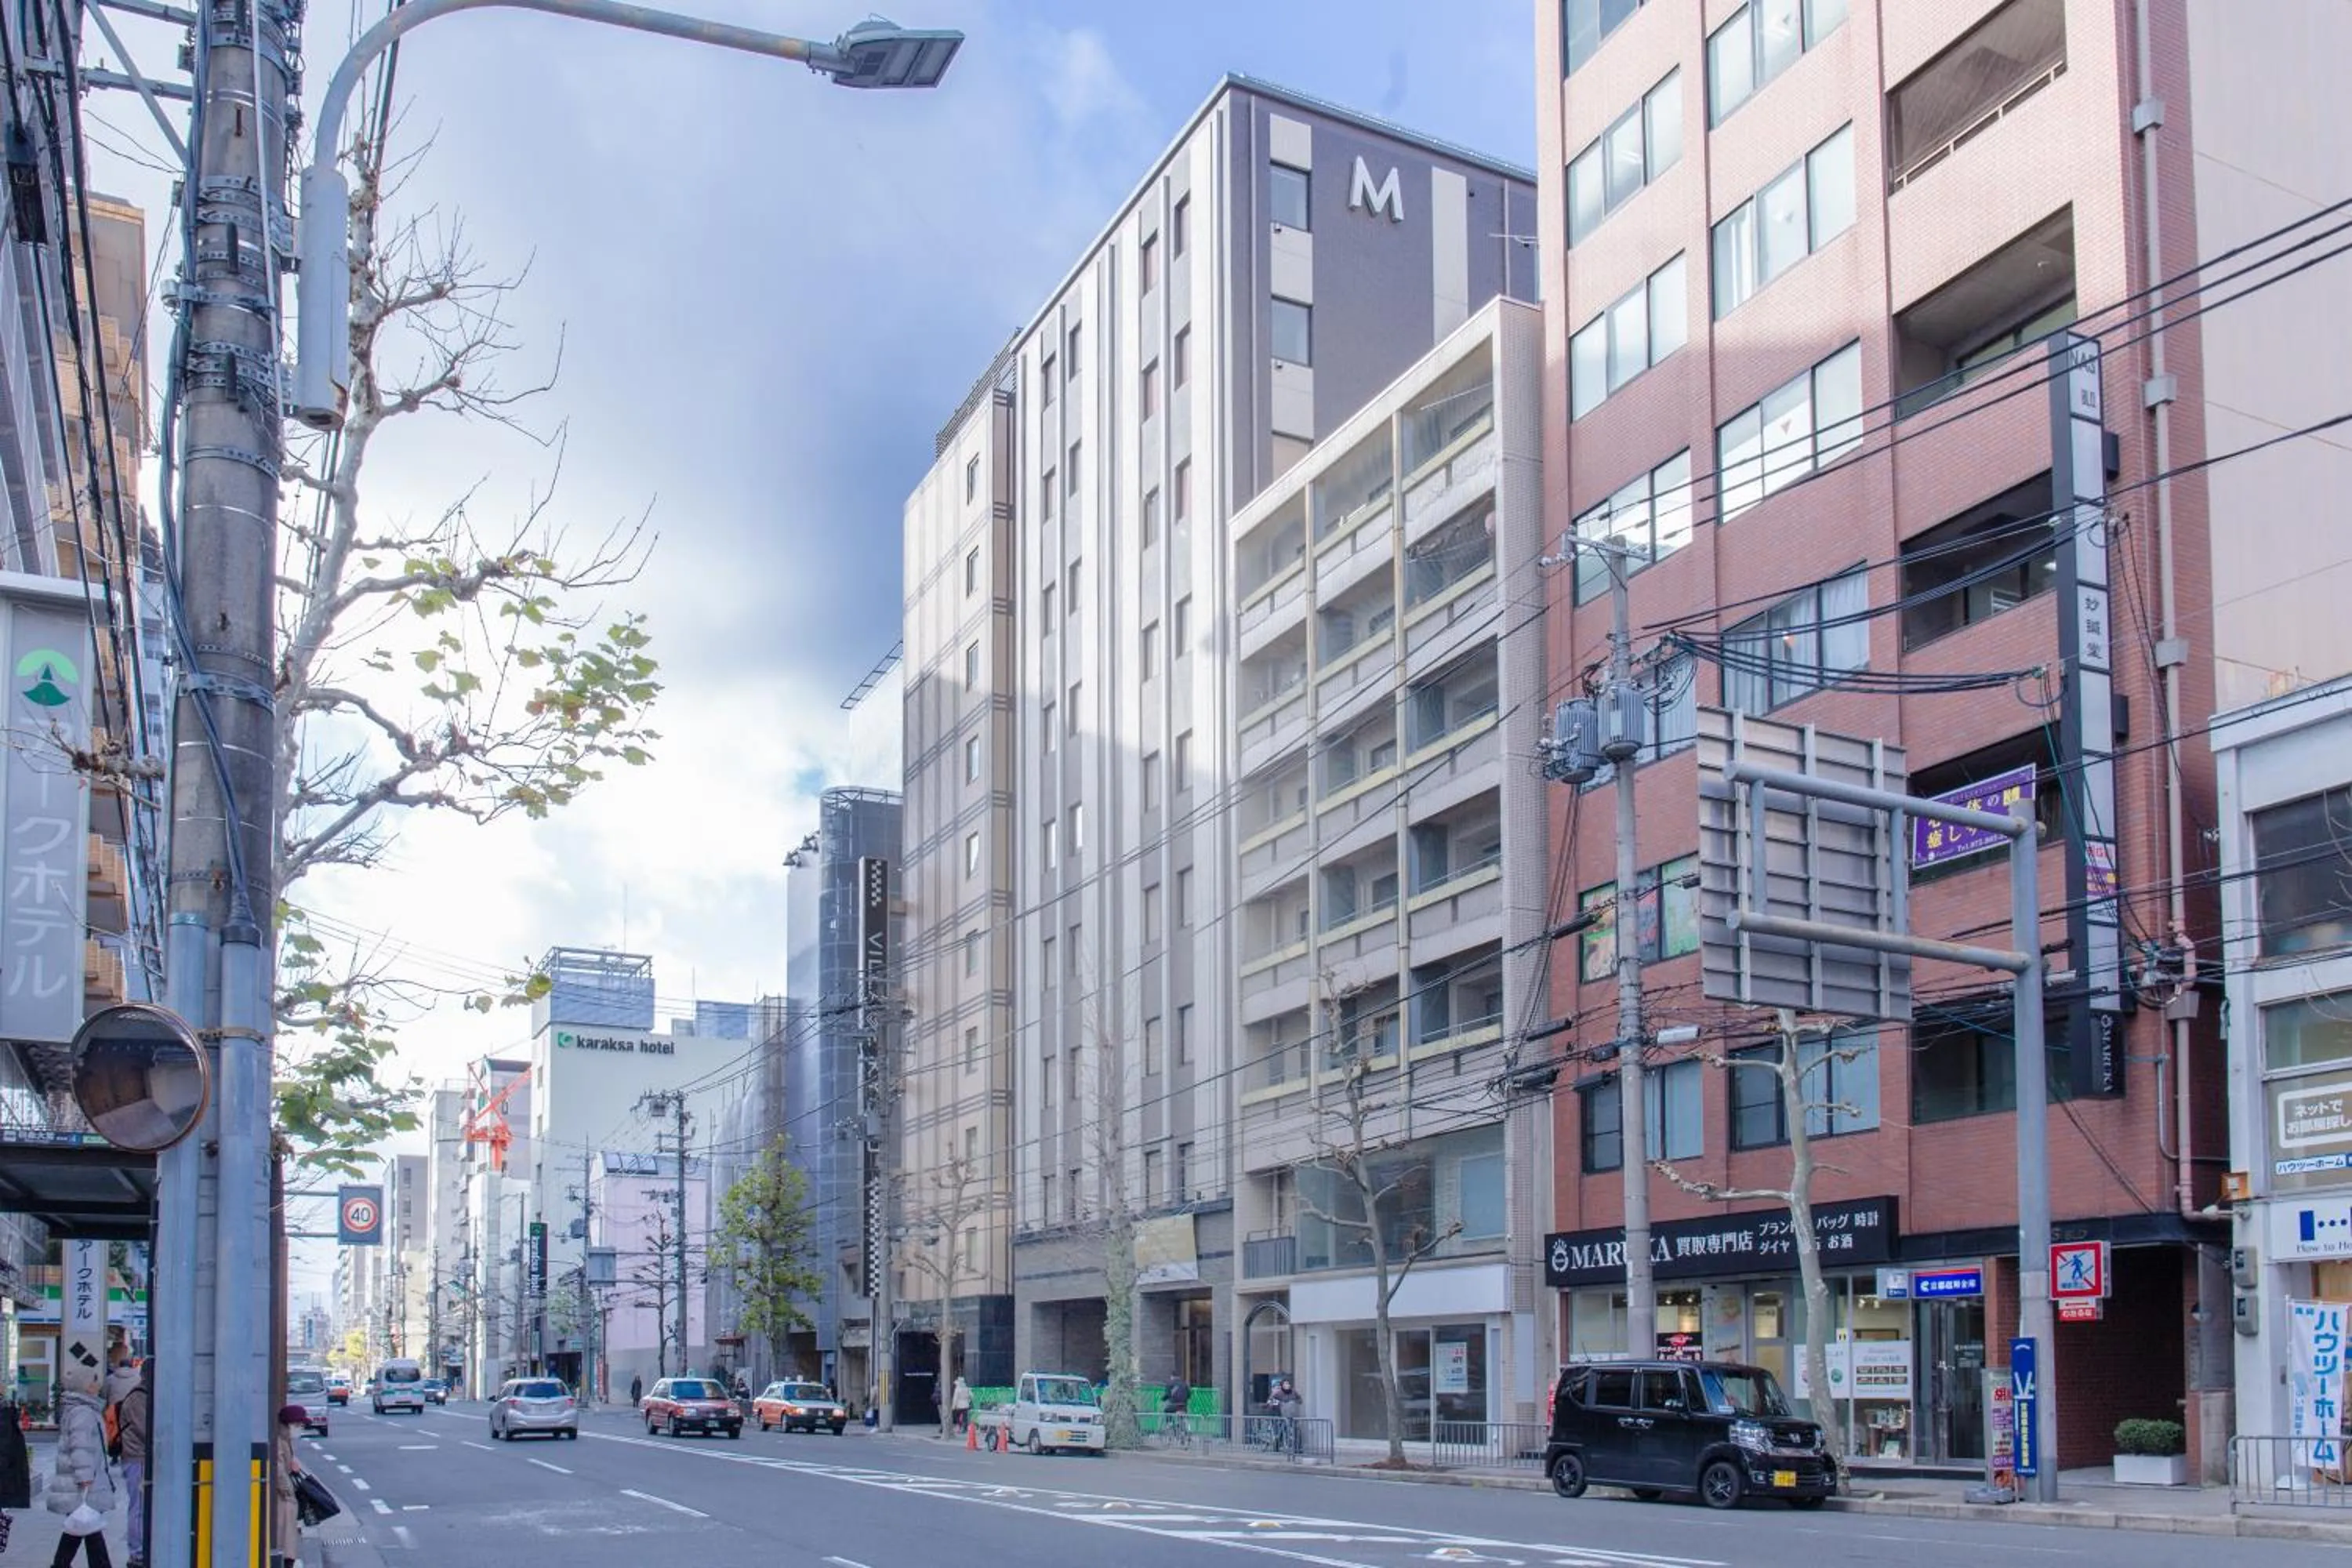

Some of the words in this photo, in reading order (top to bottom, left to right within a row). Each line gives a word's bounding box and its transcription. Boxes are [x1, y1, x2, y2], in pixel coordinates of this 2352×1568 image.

[1348, 155, 1405, 222] M
[868, 931, 884, 1048] VILLA
[576, 1035, 634, 1052] karaksa
[640, 1039, 675, 1054] hotel
[2296, 1099, 2343, 1117] ネットで
[2278, 1156, 2343, 1172] ハウツーホーム
[351, 1207, 371, 1222] 40
[1816, 1214, 1849, 1230] バッグ
[1854, 1210, 1879, 1227] 時計
[1570, 1235, 1673, 1269] MARA
[1676, 1230, 1754, 1258] 買取専門店
[1759, 1240, 1791, 1255] ダイヤ
[1828, 1233, 1853, 1250] お酒
[76, 1240, 93, 1319] アークホテル
[2314, 1310, 2339, 1461] ハウツーホーム
